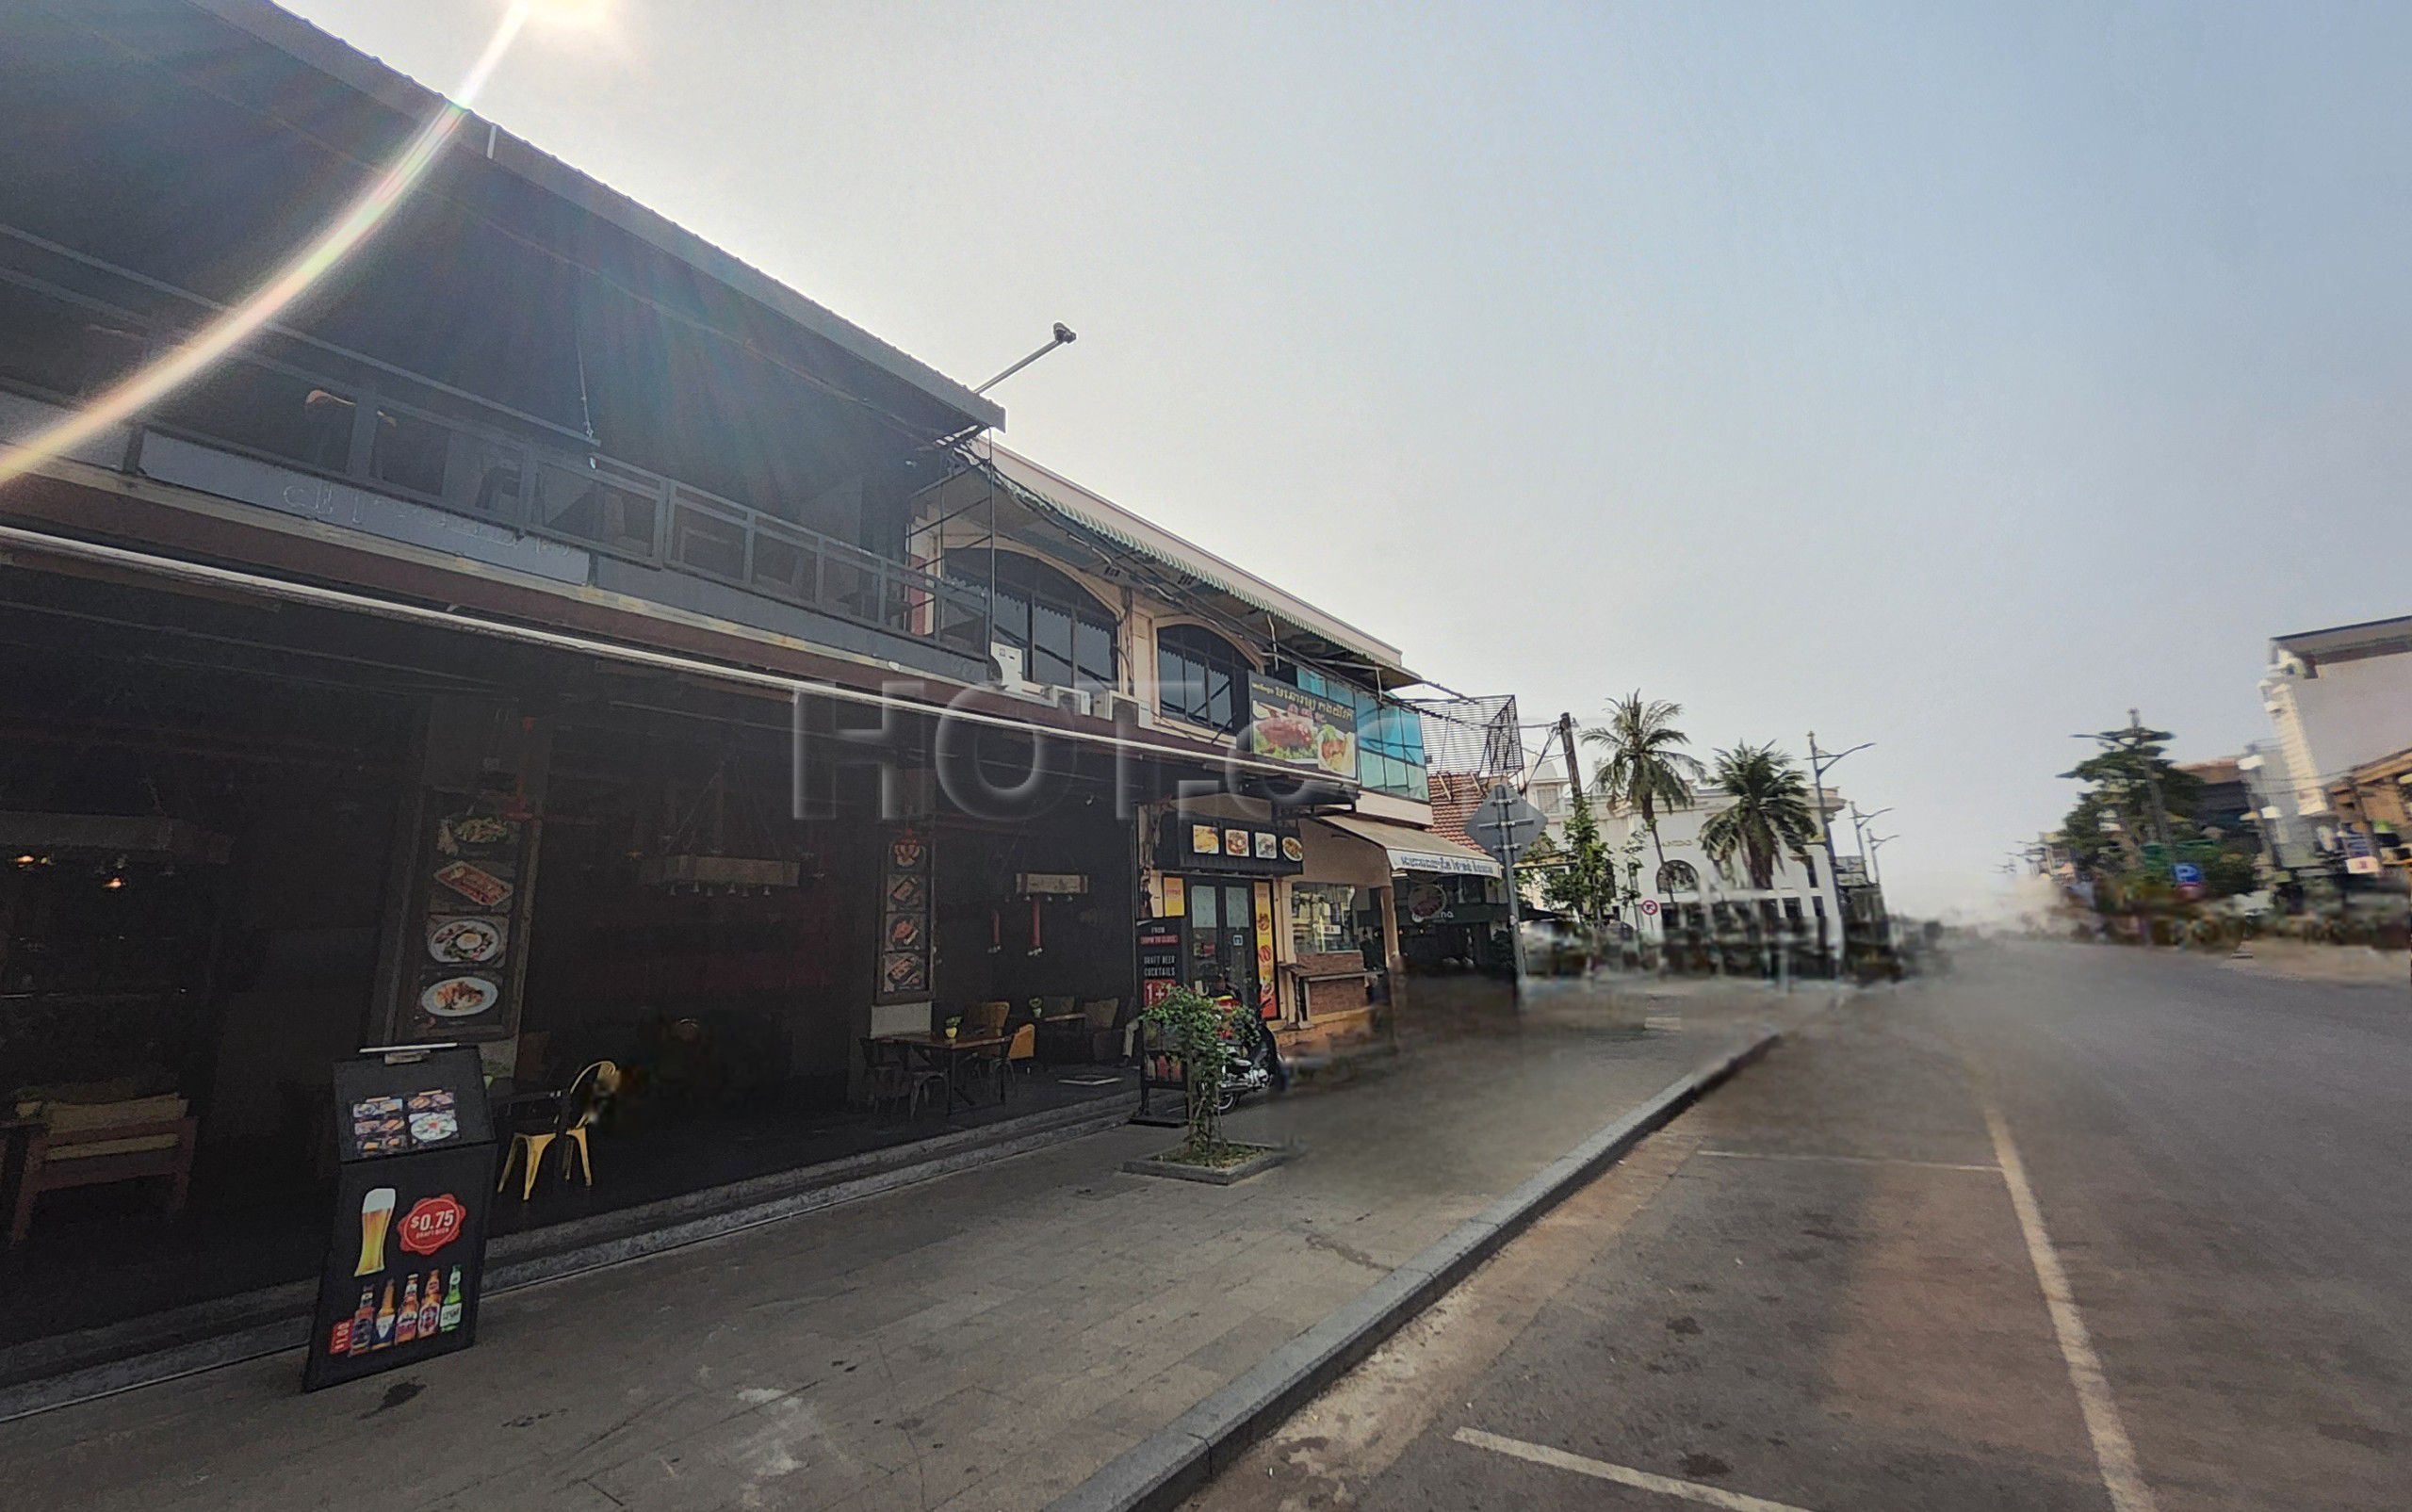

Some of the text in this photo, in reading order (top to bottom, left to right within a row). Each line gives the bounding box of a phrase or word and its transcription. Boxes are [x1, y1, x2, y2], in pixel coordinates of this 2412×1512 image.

[1144, 954, 1176, 965] DRAFT BEER
[1144, 967, 1176, 977] COCKTAILS
[410, 1209, 455, 1231] $0.75
